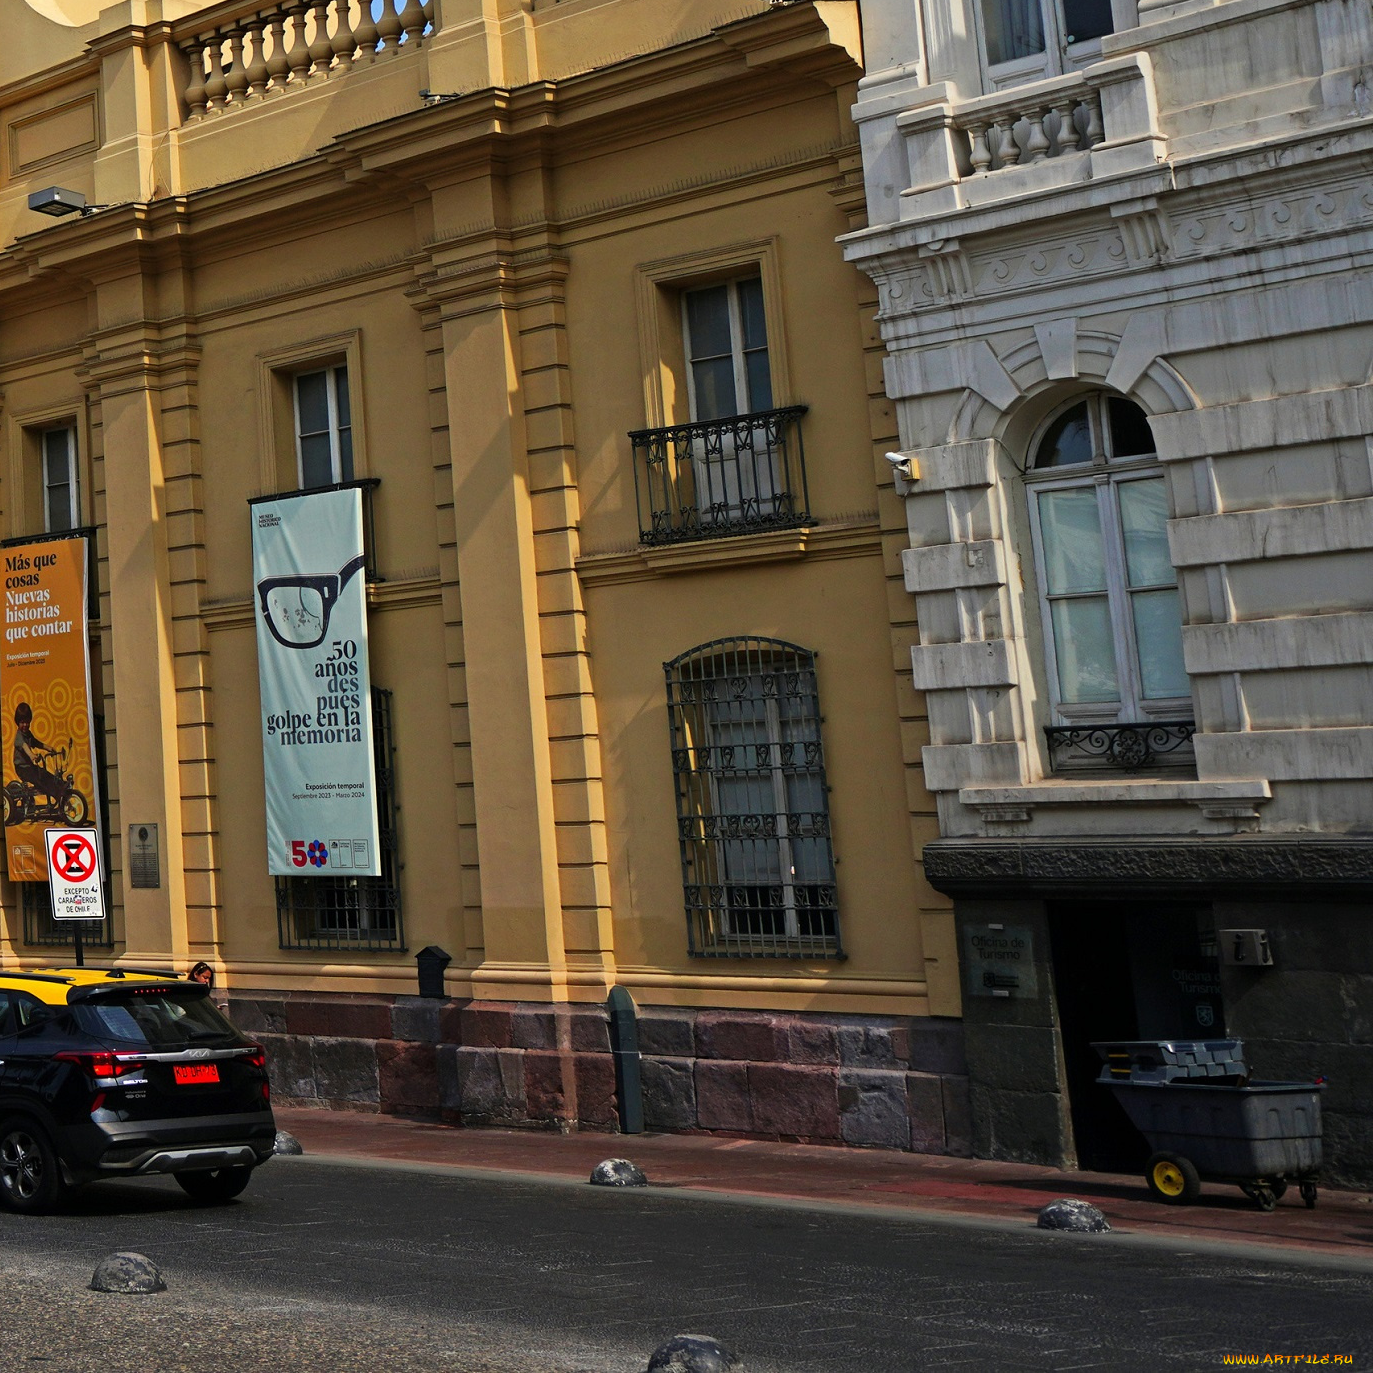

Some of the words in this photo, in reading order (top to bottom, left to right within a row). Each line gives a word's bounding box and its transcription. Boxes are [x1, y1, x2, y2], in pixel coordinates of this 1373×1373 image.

[5, 553, 30, 573] Más
[33, 553, 57, 571] que
[5, 573, 40, 589] cosas
[6, 588, 51, 606] Nuevas
[6, 602, 60, 623] historias
[5, 626, 29, 644] que
[31, 620, 73, 637] contar
[29, 650, 50, 658] temporal
[332, 639, 357, 661] 50
[314, 656, 359, 678] años
[327, 675, 360, 694] des
[316, 689, 361, 715] pués
[267, 710, 312, 735] golpe
[316, 710, 339, 727] en
[344, 707, 361, 727] la
[280, 727, 362, 746] memoria
[305, 782, 337, 791] Exposición
[337, 782, 365, 791] temporal
[64, 887, 90, 895] EXCEPTO
[66, 905, 74, 913] DE
[972, 935, 1008, 947] Oficina
[1011, 937, 1024, 948] de
[976, 948, 1021, 960] Turismo
